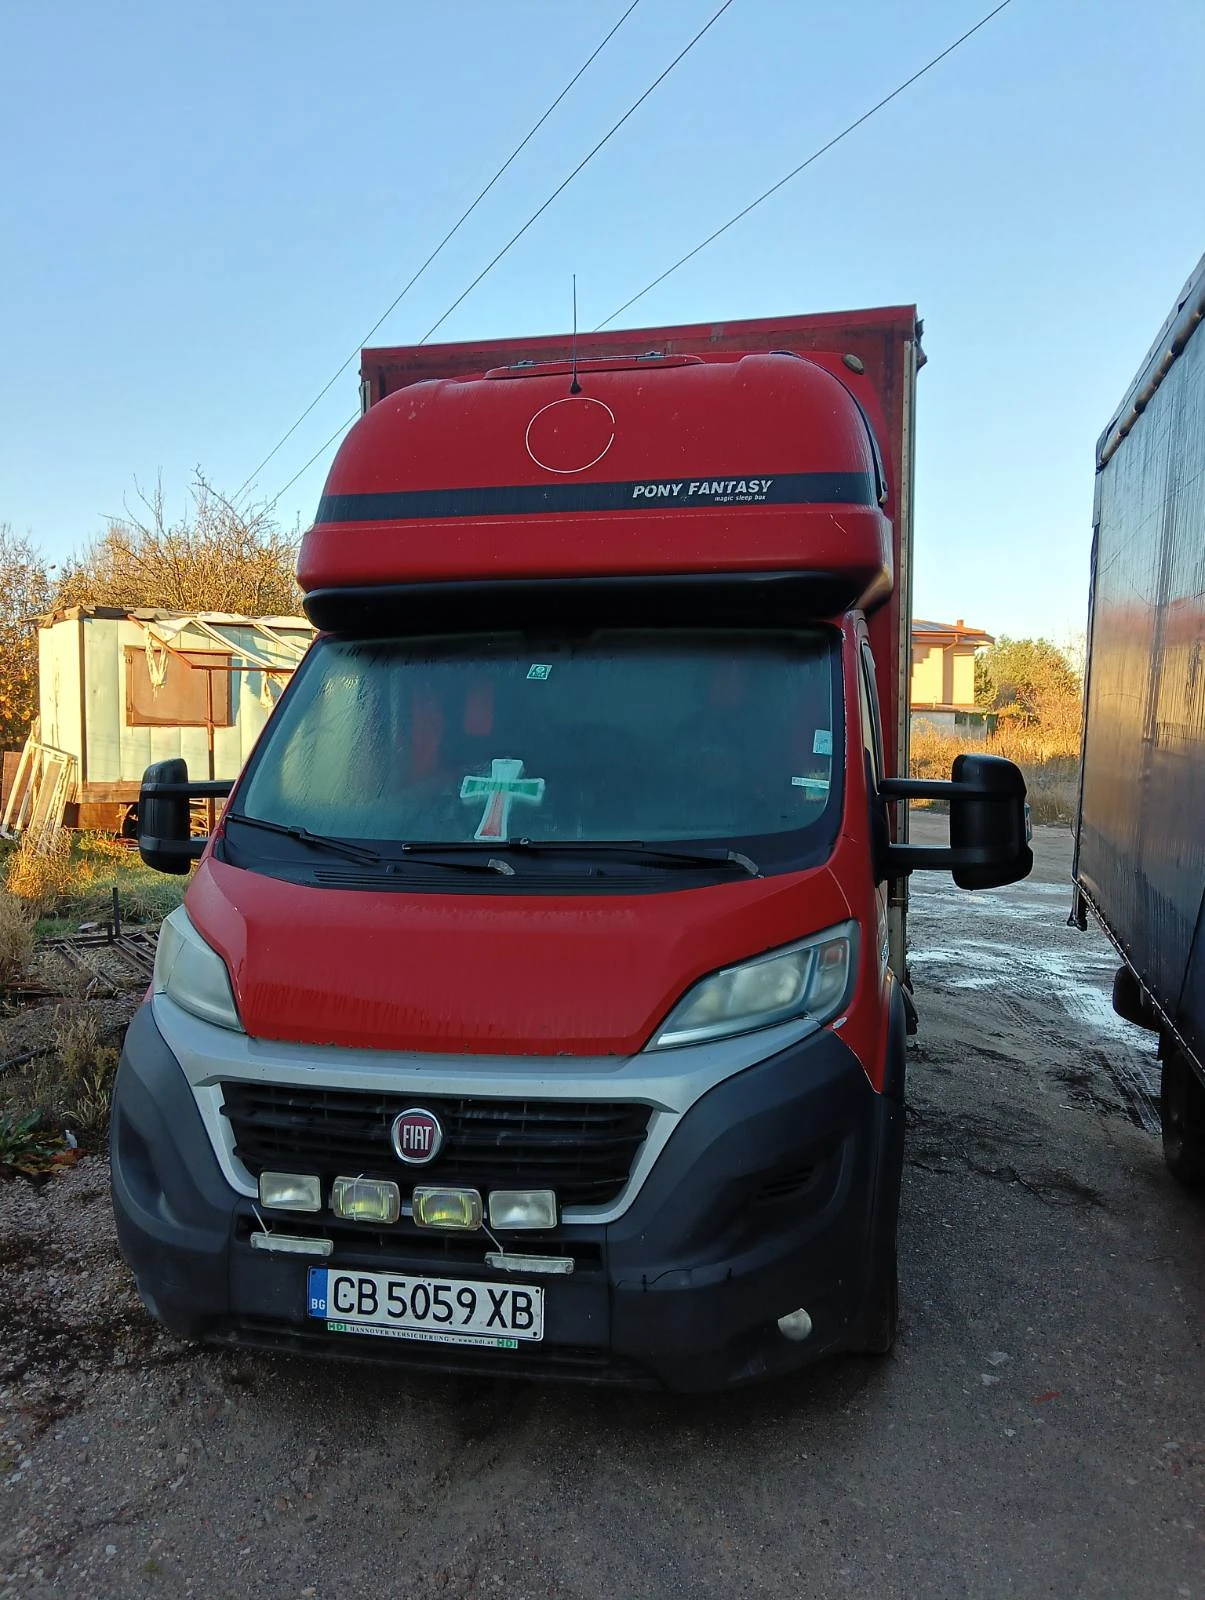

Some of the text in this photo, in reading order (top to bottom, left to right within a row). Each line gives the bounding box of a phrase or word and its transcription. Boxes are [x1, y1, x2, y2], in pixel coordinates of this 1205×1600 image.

[632, 479, 774, 498] PONY FANTASY
[714, 493, 766, 503] magic sleep box
[402, 1124, 433, 1150] FIAT
[311, 1298, 326, 1310] BG
[333, 1276, 534, 1330] CB 5059 XB
[328, 1322, 347, 1332] HDI
[350, 1326, 390, 1336] HANNOVER
[392, 1330, 449, 1342] VERSICHERUNG
[497, 1340, 517, 1348] HDI
